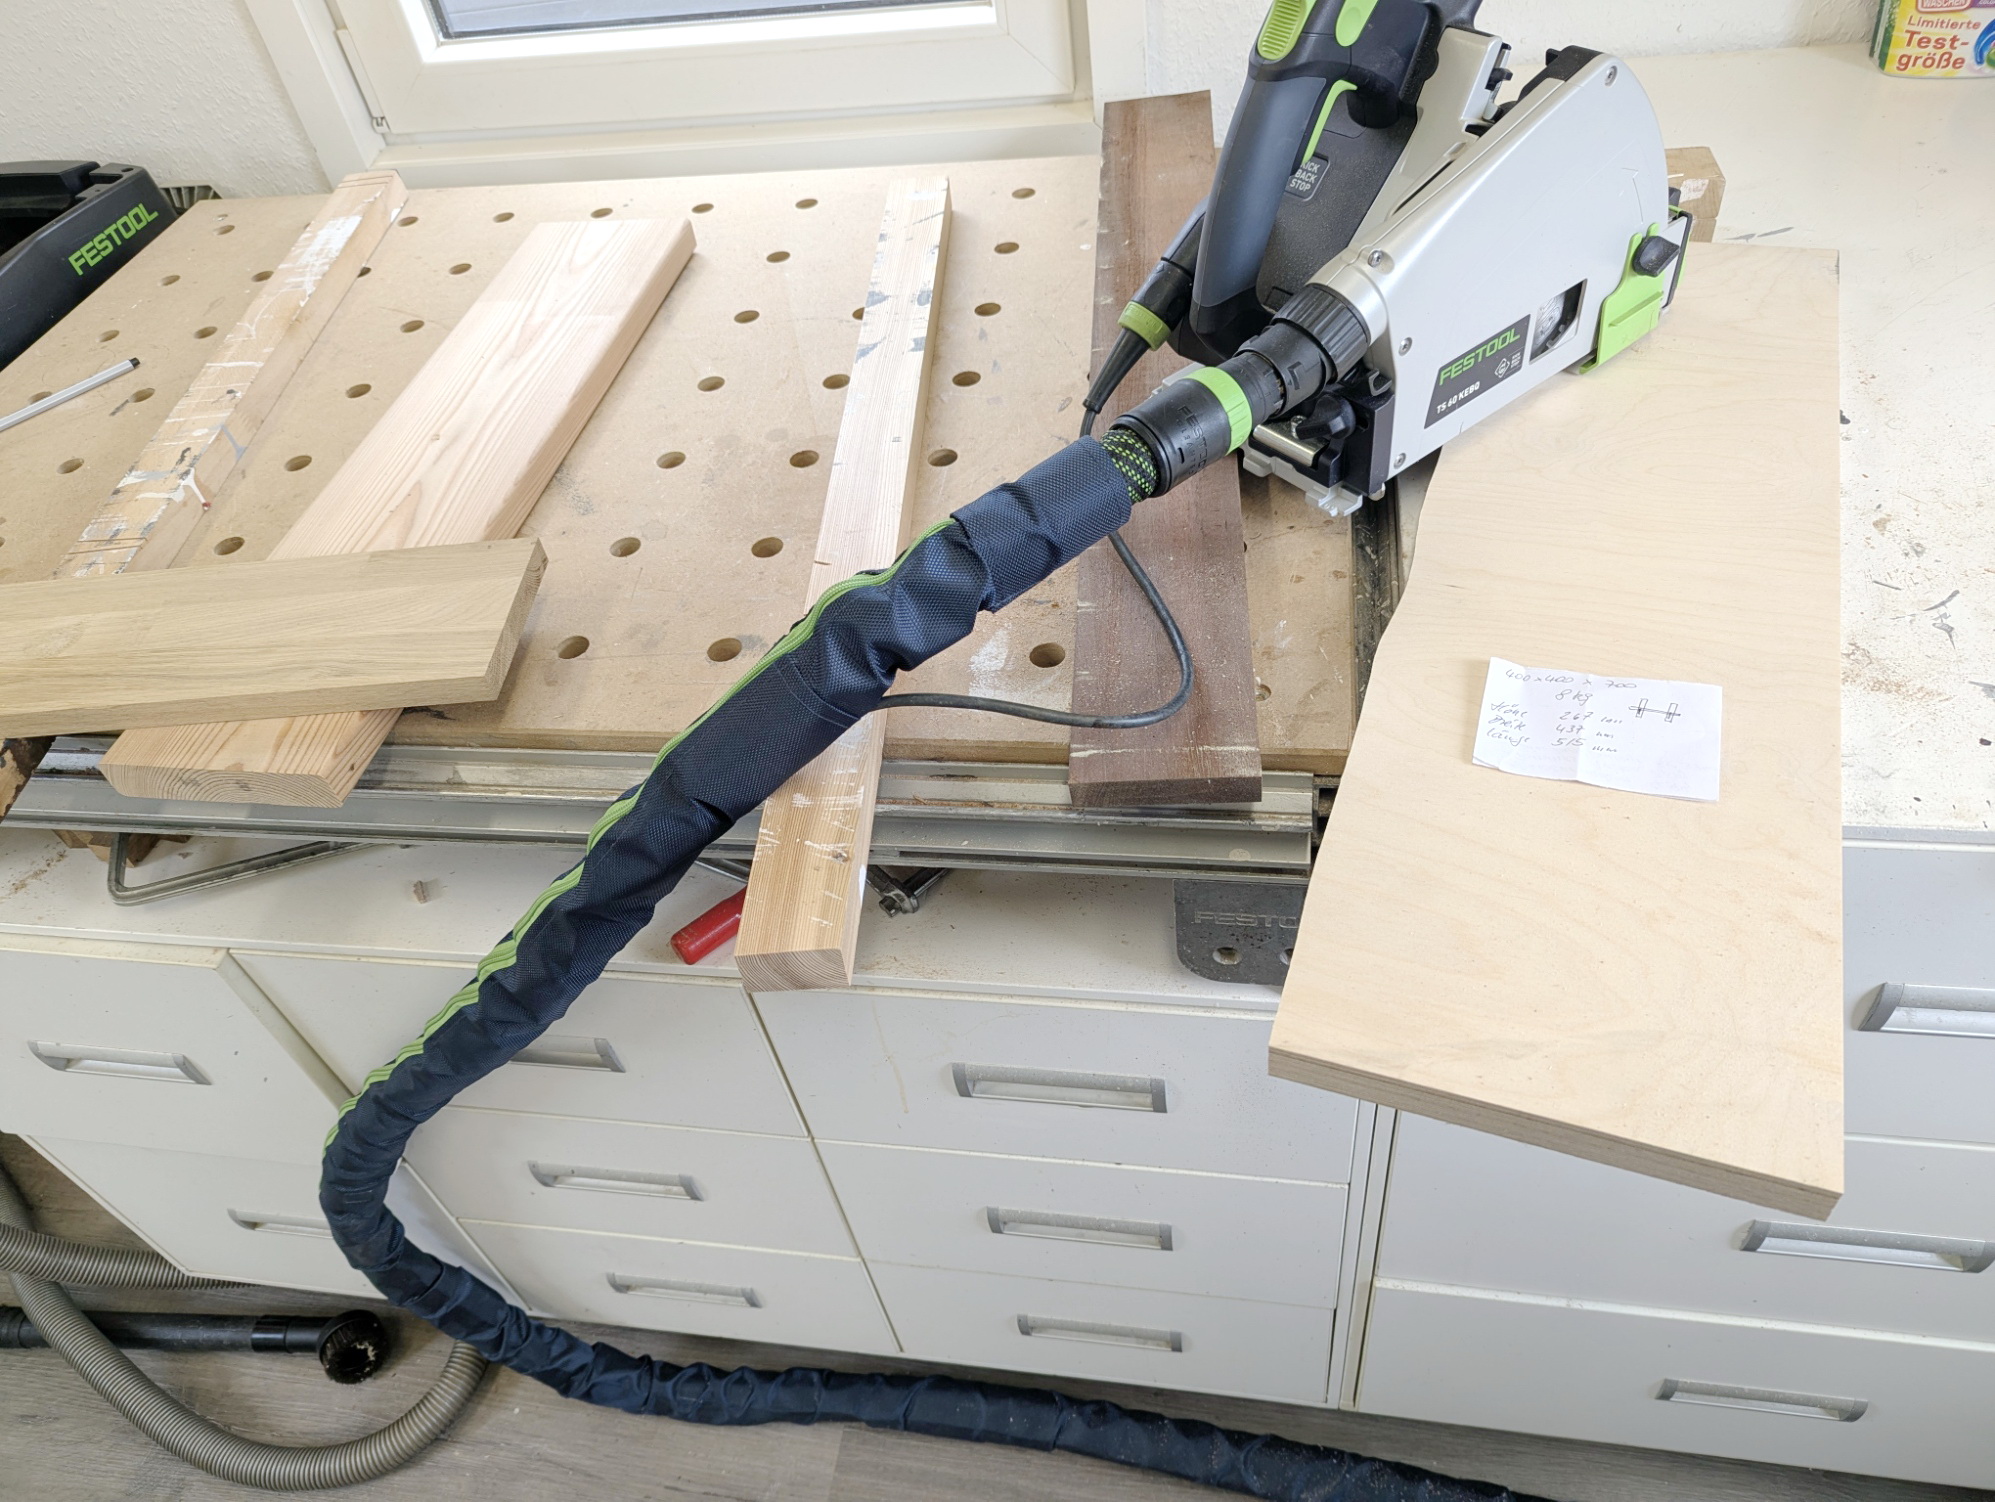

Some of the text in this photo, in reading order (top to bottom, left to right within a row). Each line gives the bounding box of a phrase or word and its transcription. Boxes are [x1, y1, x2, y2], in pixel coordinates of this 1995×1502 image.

[1907, 15, 1981, 30] Limitierte
[1904, 29, 1969, 50] Test-
[1896, 51, 1966, 72] größe
[1289, 178, 1312, 192] STOP
[1294, 169, 1318, 184] BACK
[68, 203, 159, 276] FESTOOL
[1439, 328, 1520, 385] FESTOOL
[1436, 401, 1447, 414] TS
[1177, 405, 1208, 469] FESTOO
[1195, 911, 1300, 928] FESTO
